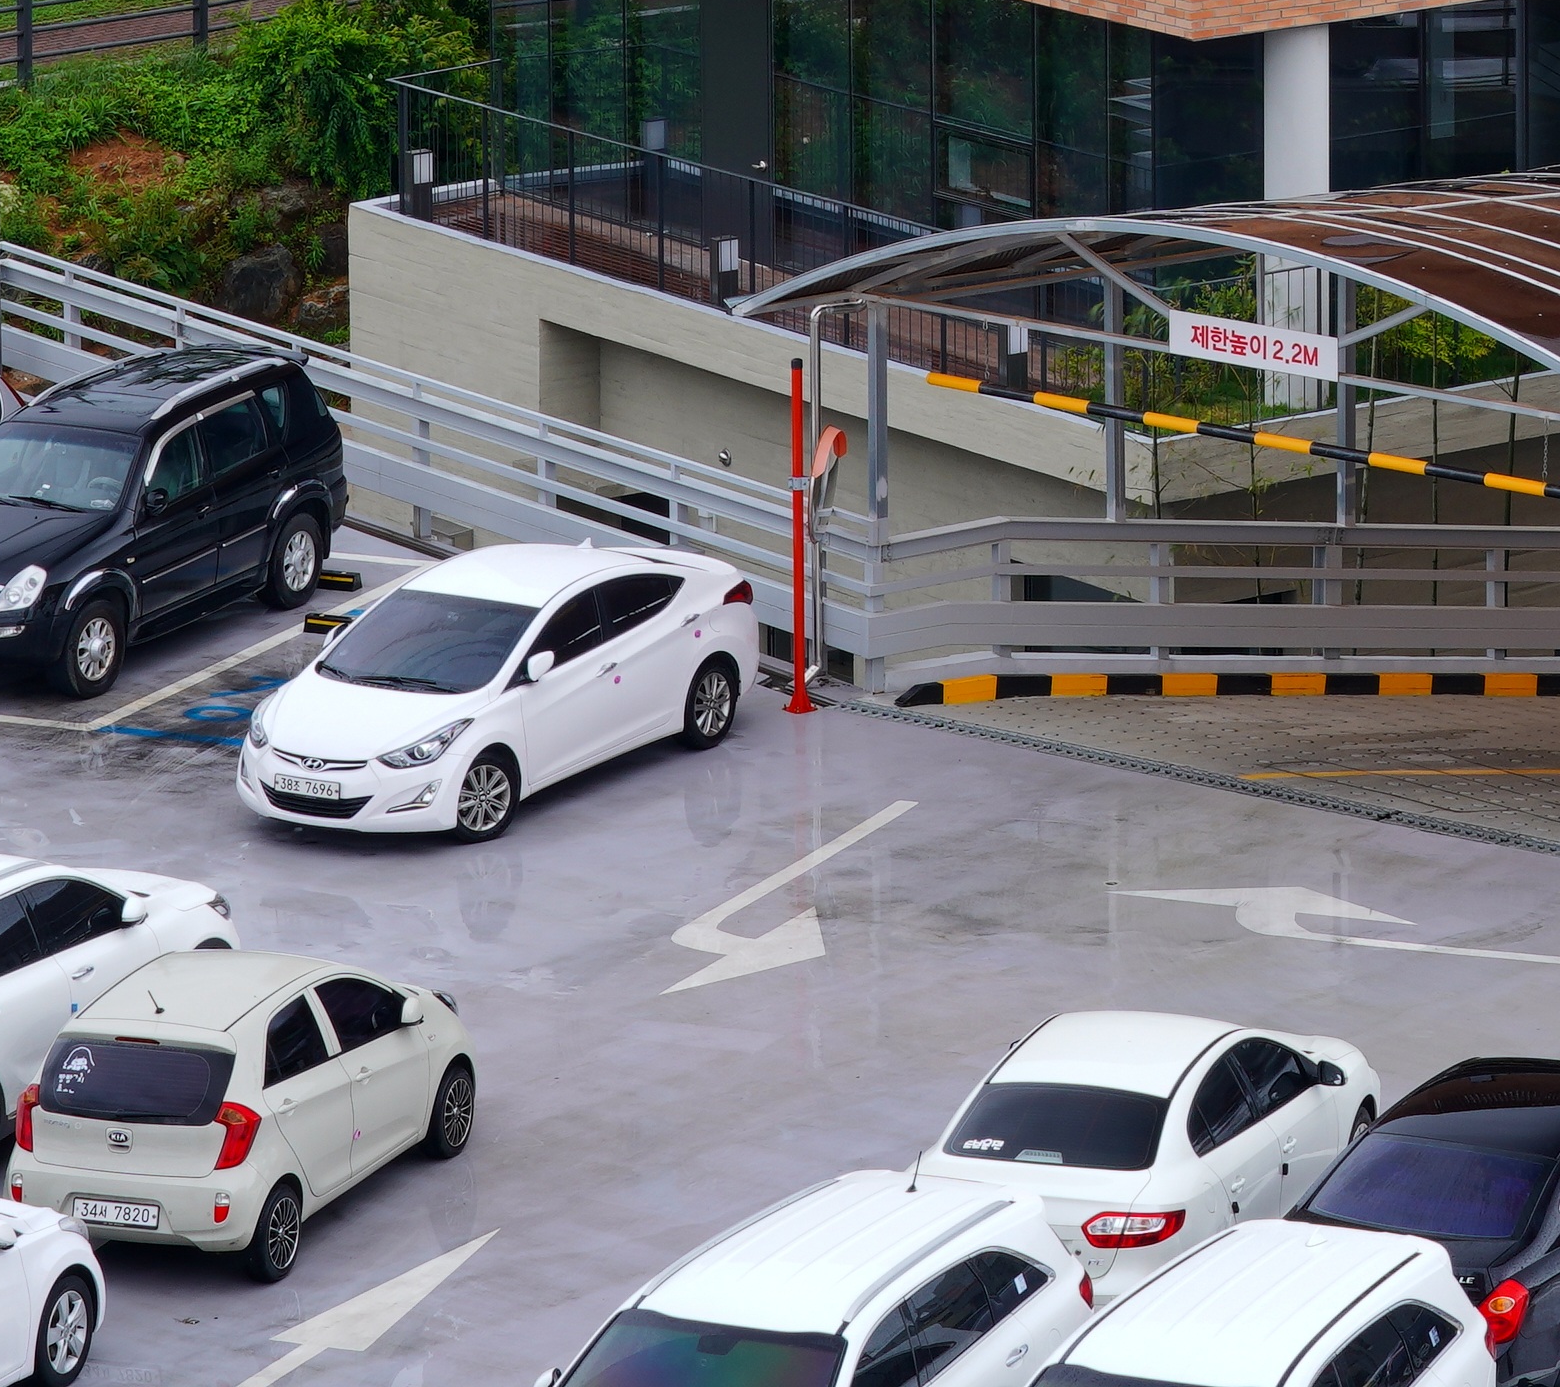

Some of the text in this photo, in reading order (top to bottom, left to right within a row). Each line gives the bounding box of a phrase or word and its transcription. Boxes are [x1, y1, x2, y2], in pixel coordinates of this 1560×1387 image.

[1190, 324, 1319, 367] 제한높이 2.2M
[280, 777, 333, 797] 38조 7696
[111, 1132, 127, 1142] KIA
[81, 1203, 150, 1223] 34서 7820
